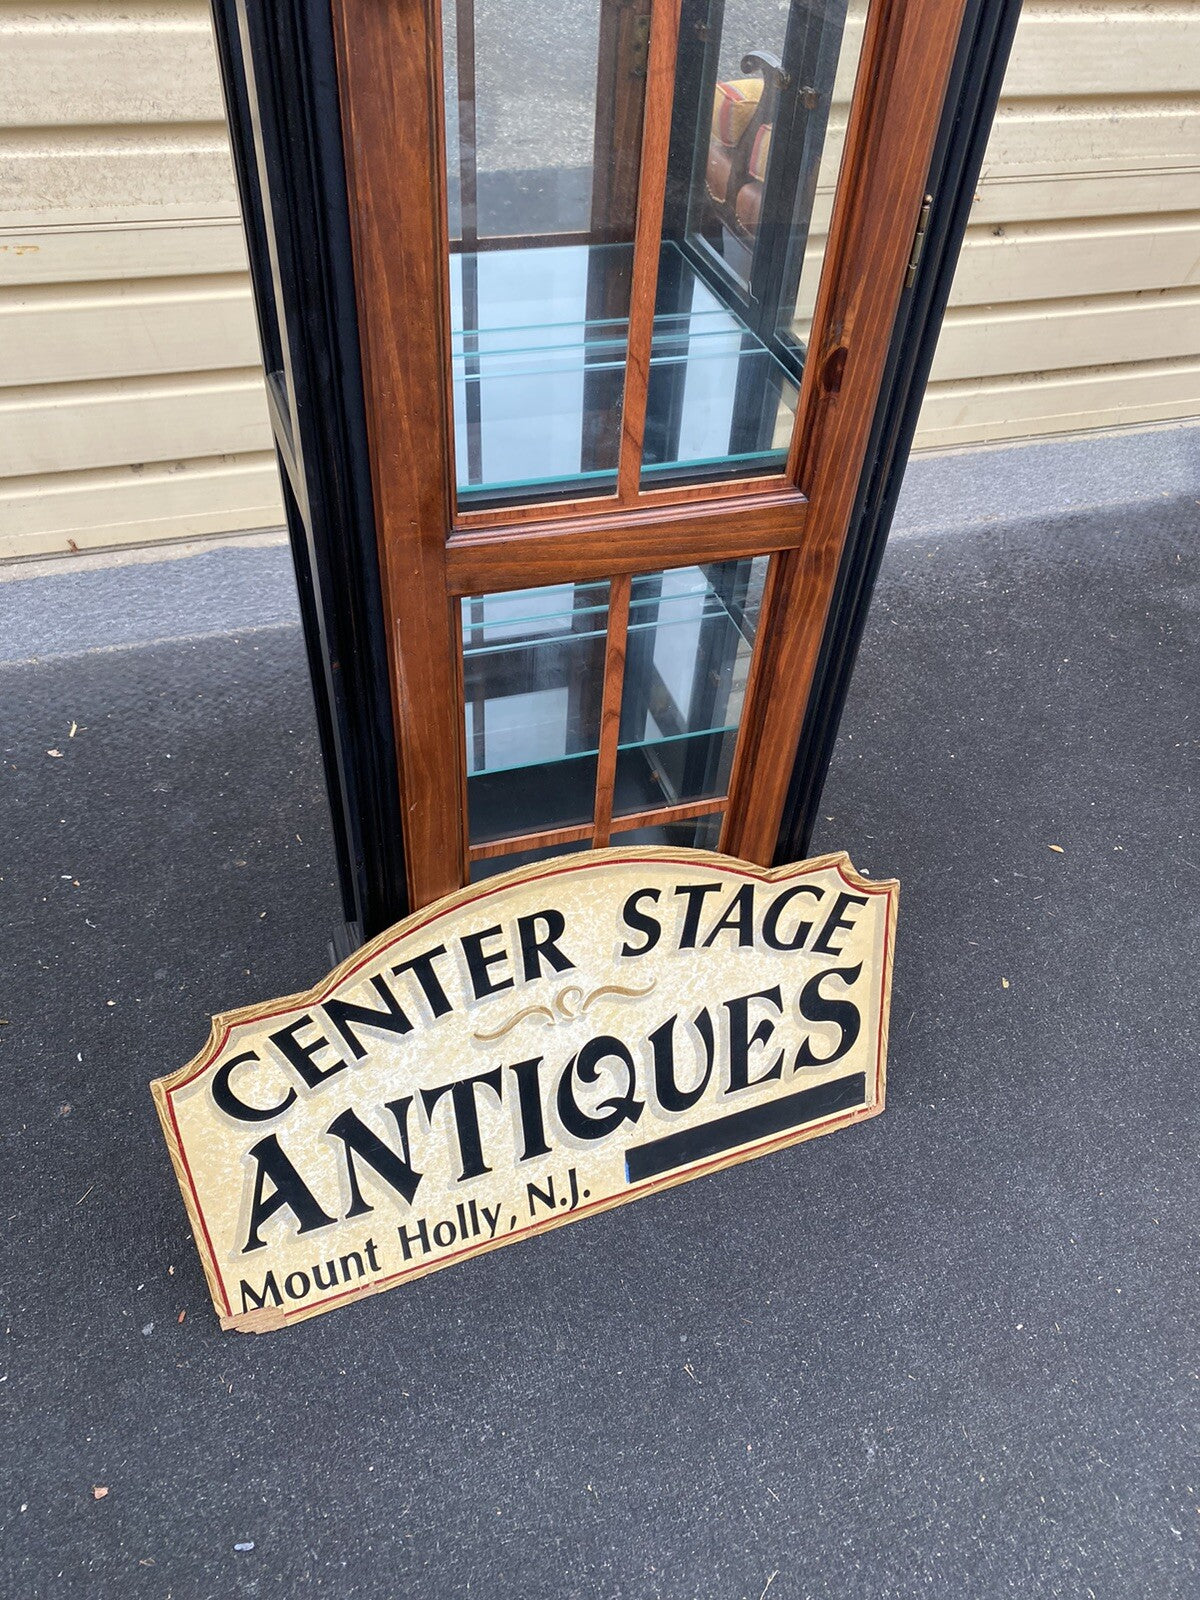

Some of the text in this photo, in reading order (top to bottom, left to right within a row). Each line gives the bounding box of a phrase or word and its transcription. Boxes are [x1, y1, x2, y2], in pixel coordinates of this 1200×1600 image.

[211, 882, 870, 1122] CENTER STAGE
[242, 961, 863, 1254] ANTIQUES
[238, 1168, 591, 1314] Mount Holly, N.J.
